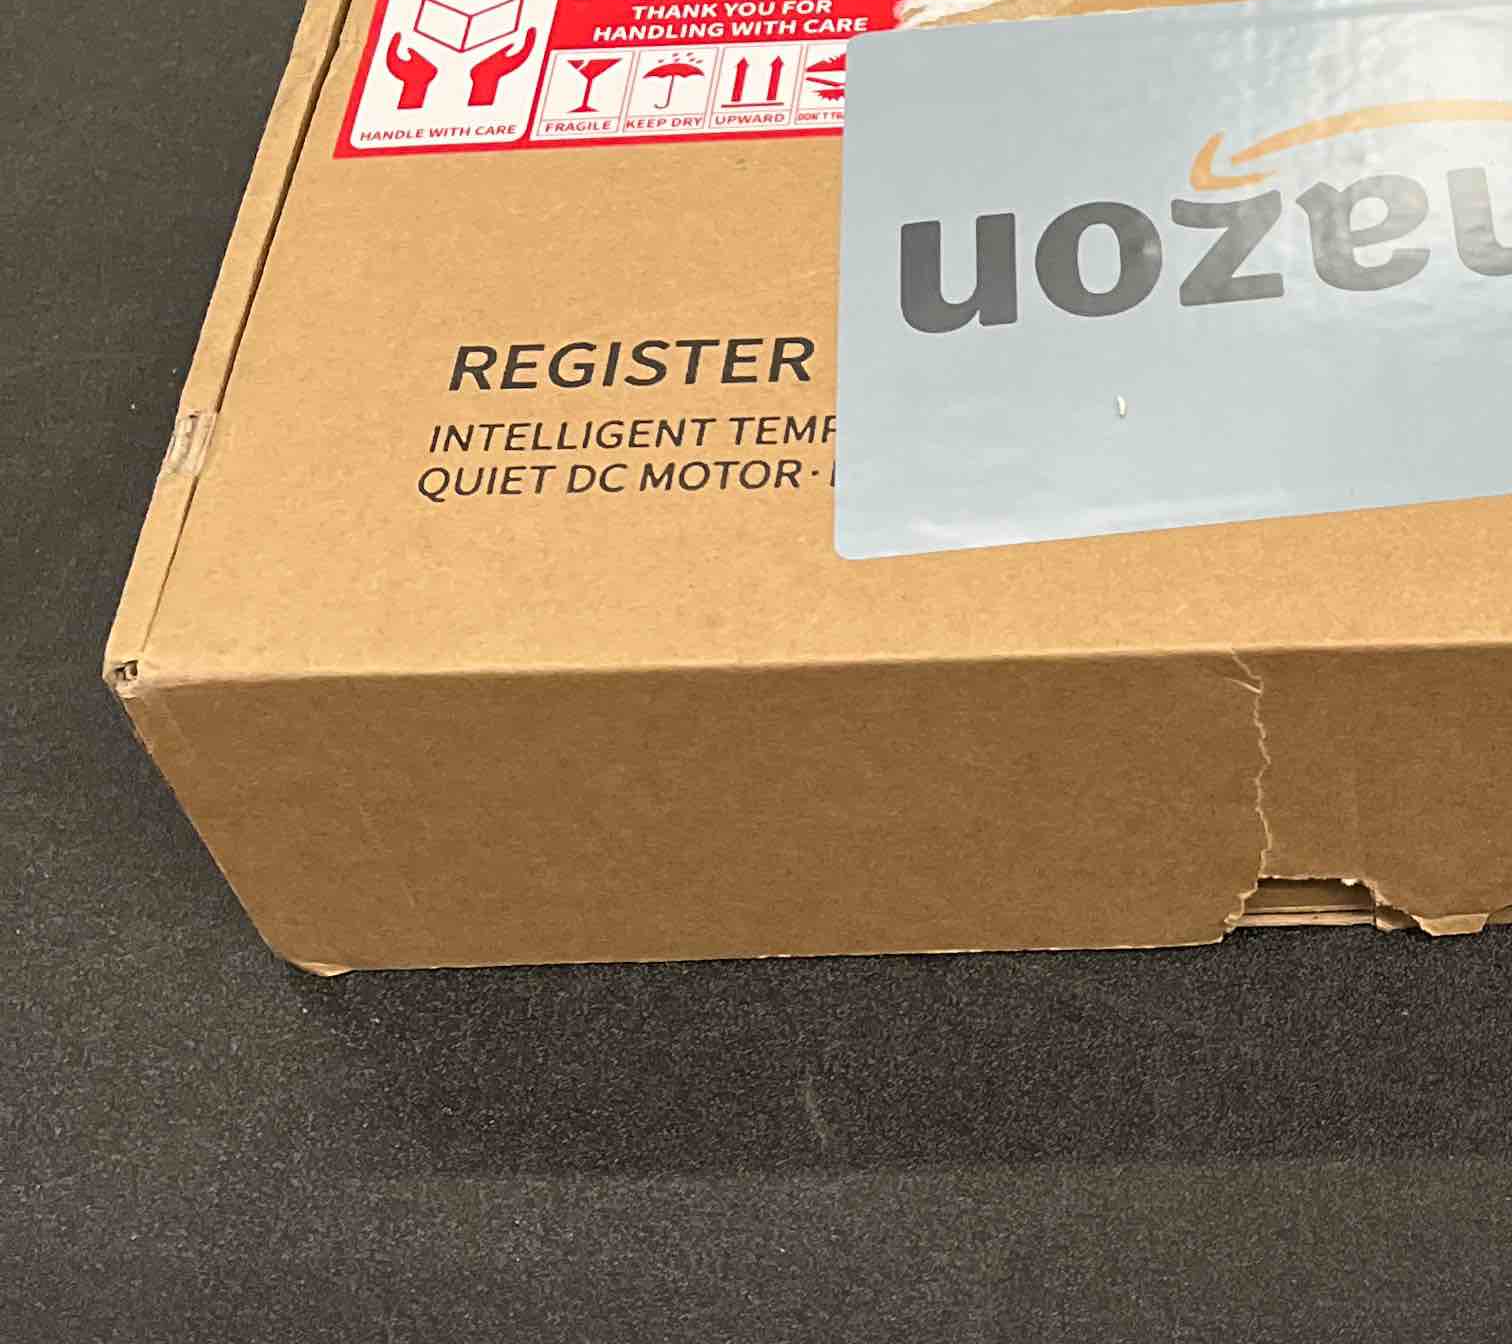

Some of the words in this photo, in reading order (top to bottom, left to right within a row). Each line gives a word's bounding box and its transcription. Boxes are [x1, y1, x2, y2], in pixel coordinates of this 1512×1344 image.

[632, 3, 718, 21] THANK
[724, 1, 776, 18] YOU
[782, 0, 832, 16] FOR
[592, 24, 725, 42] HANDLING
[731, 20, 797, 37] WITH
[803, 17, 868, 34] CARE
[544, 119, 613, 133] FRAGILE
[625, 118, 667, 130] KEEP
[671, 116, 705, 128] DRY
[715, 112, 786, 126] UPWARD
[360, 128, 426, 142] HANDLE
[429, 126, 471, 138] WITH
[475, 124, 518, 136] CARE
[448, 336, 815, 391] REGISTER
[429, 417, 717, 453] INTELLIGENT
[417, 464, 556, 503] QUIET
[566, 462, 628, 494] DC
